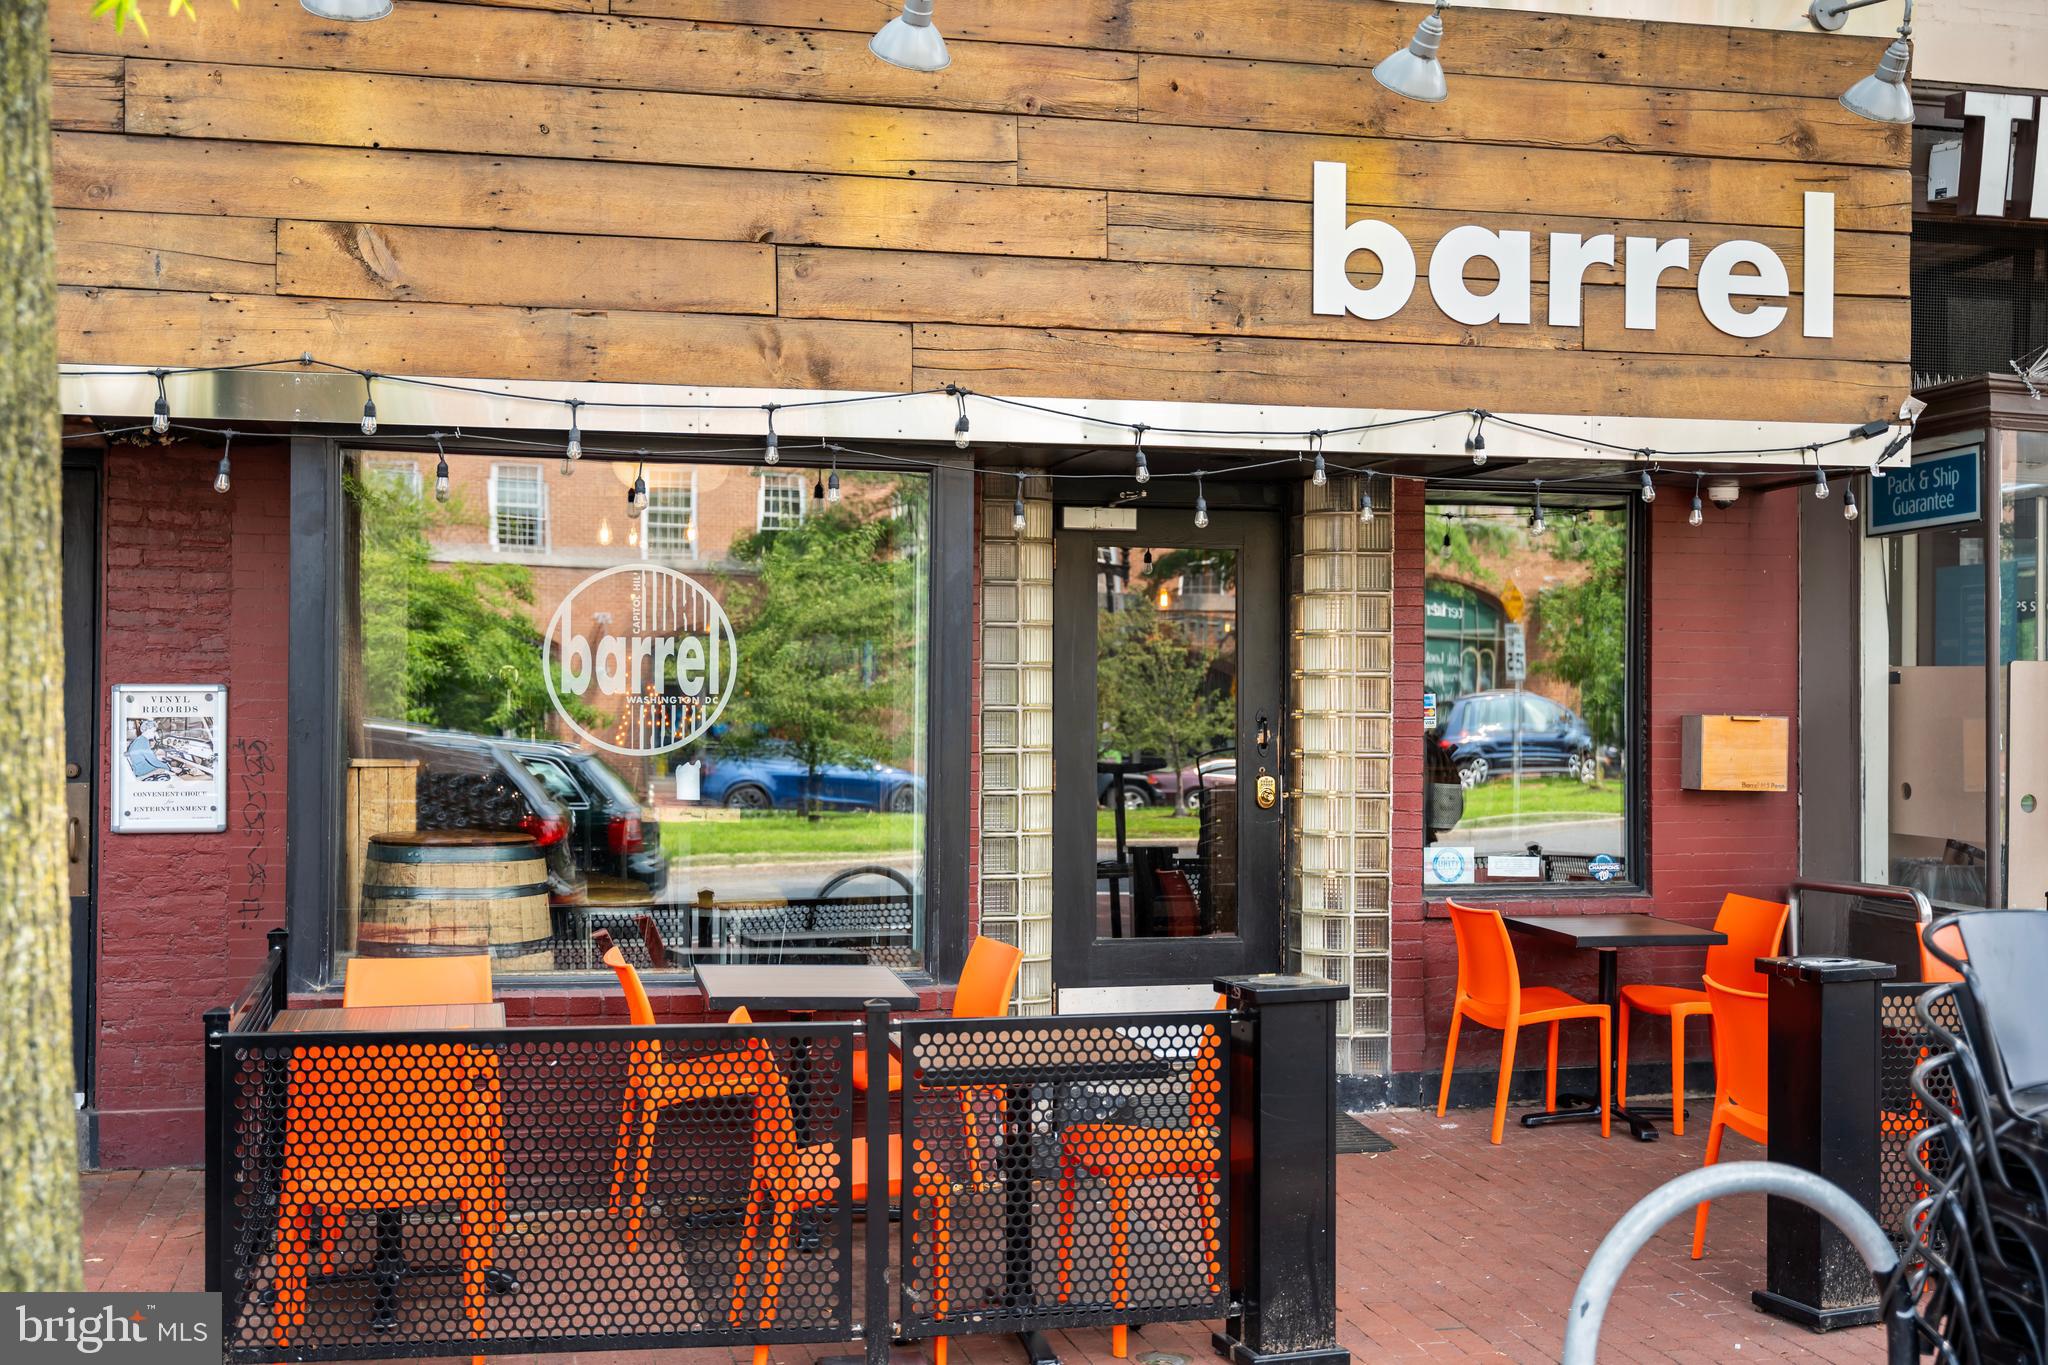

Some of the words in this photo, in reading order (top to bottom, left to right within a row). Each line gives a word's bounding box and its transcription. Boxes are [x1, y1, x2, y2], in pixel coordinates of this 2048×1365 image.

[1313, 161, 1835, 338] barrel
[1888, 473, 1915, 495] Pack
[1919, 470, 1929, 489] &
[1933, 466, 1960, 490] Ship
[1893, 493, 1955, 516] Guarantee
[632, 594, 641, 635] CAPITOL
[561, 600, 720, 696] barrel
[142, 705, 199, 713] RECORDS
[151, 695, 191, 704] VINYL
[626, 696, 700, 705] WASHINGTON
[705, 696, 719, 705] DC
